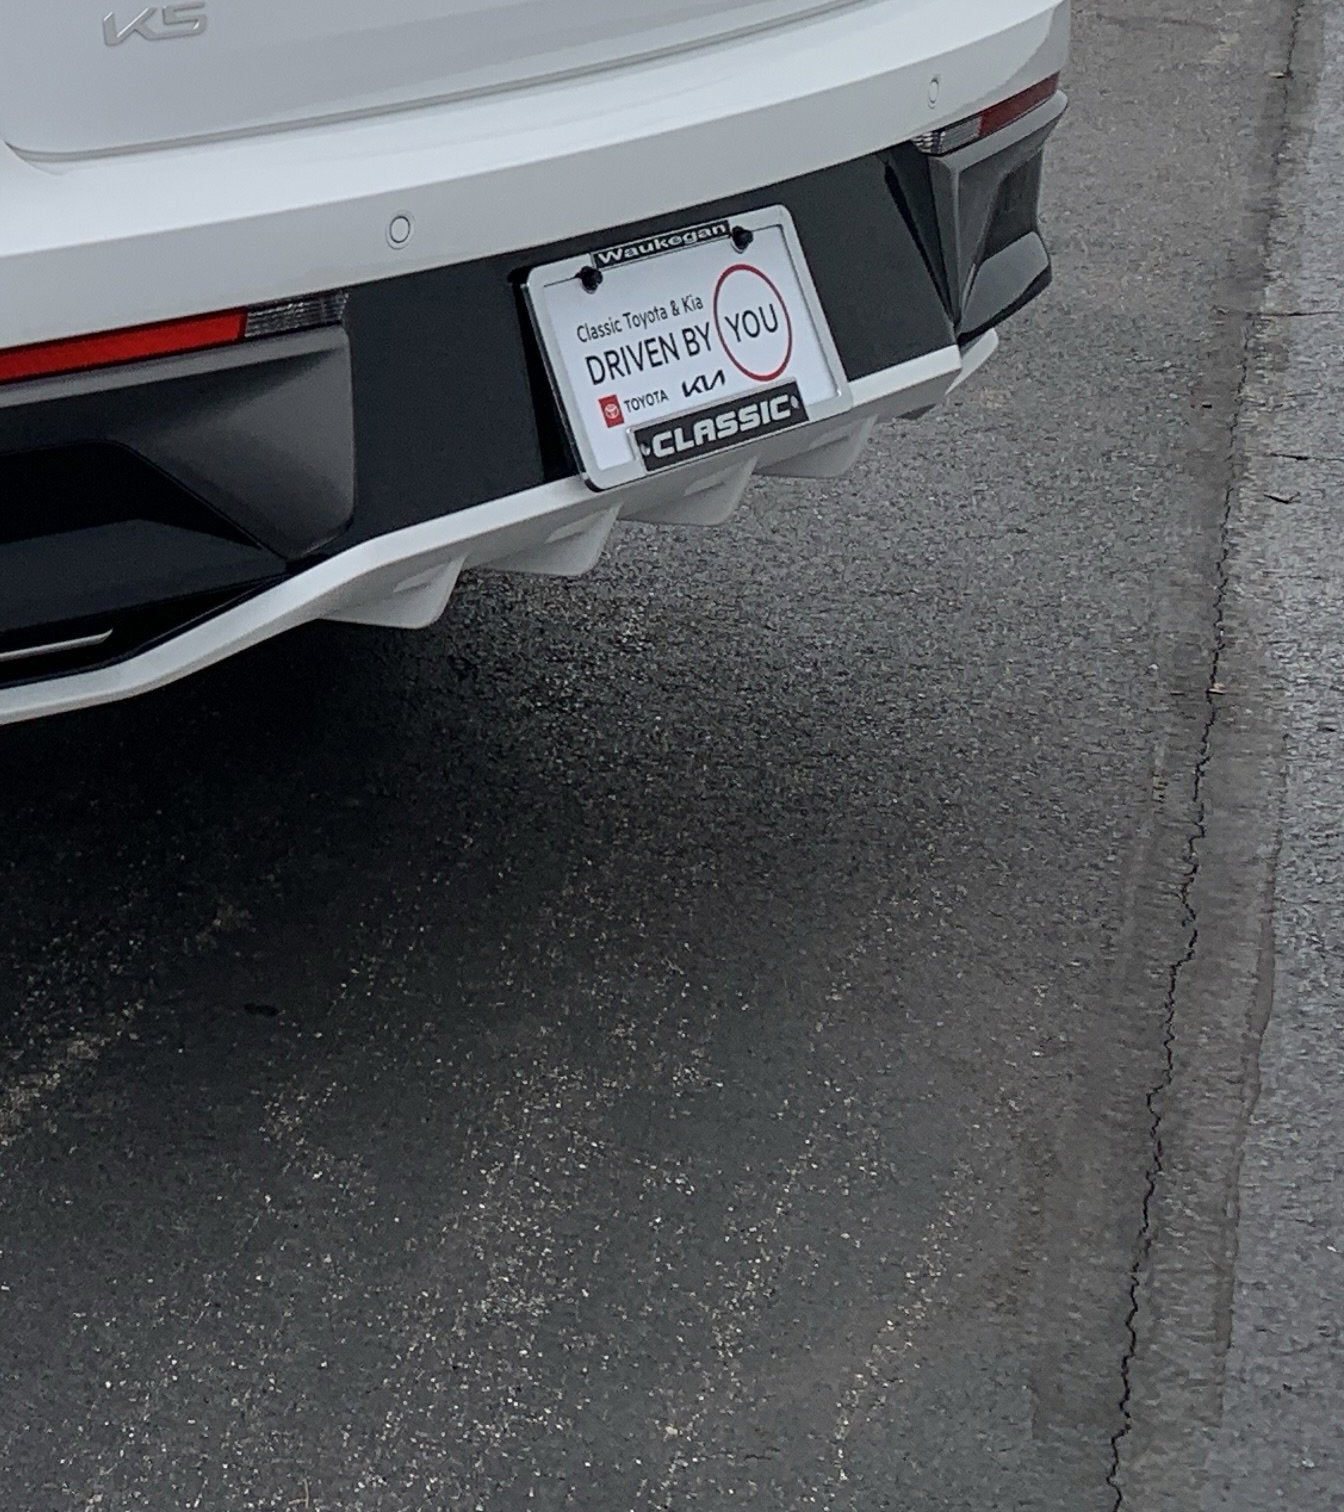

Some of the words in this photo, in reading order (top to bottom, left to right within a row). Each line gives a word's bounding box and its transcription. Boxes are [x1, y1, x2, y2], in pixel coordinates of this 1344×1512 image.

[102, 0, 208, 47] K5
[598, 222, 728, 264] Waukegan
[577, 317, 622, 343] Classic
[623, 303, 668, 329] Toyota
[669, 300, 681, 317] &
[682, 294, 704, 314] Kia
[585, 332, 680, 385] DRIVEN
[682, 322, 712, 357] BY
[725, 303, 779, 343] YOU
[624, 390, 670, 414] TOYOTA
[651, 394, 792, 459] CLASSIC
